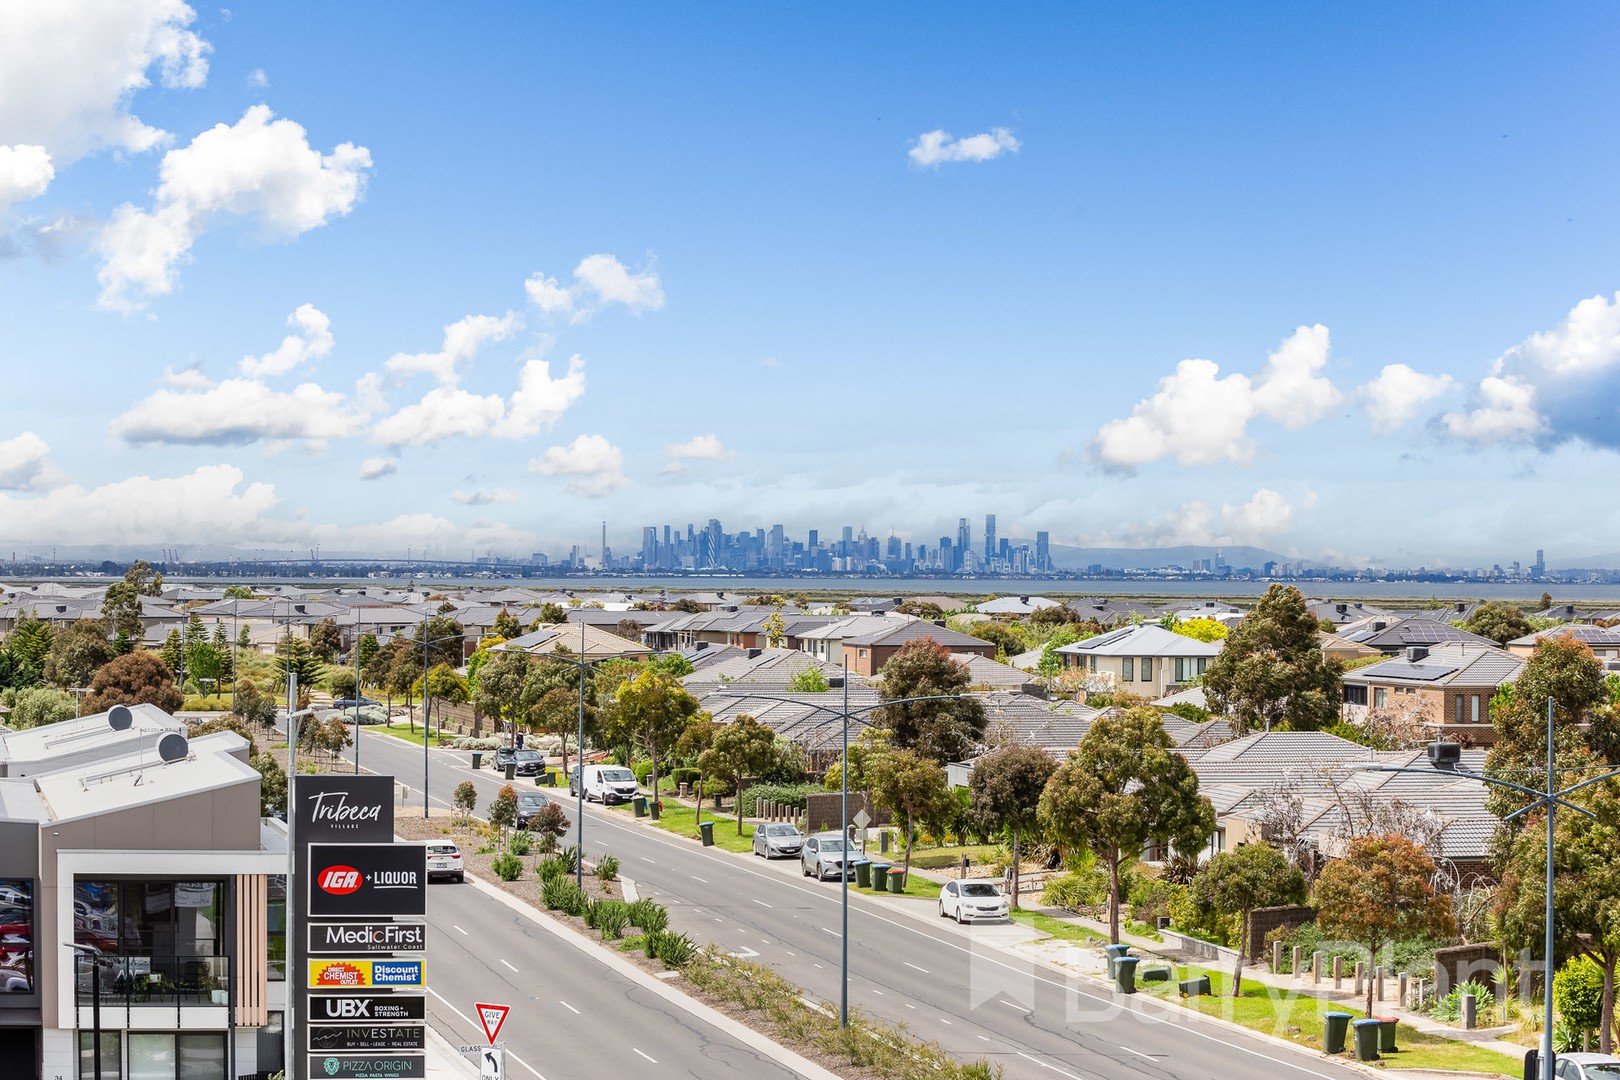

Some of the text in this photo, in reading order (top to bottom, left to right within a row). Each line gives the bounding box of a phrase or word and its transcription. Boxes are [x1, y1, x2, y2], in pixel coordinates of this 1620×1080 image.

[308, 791, 382, 823] Tribeca
[322, 871, 359, 889] IGA
[373, 871, 417, 885] LIQUOR
[325, 925, 423, 944] MedicFirst
[374, 965, 419, 974] Discount
[323, 971, 359, 980] CHEMIST
[374, 973, 417, 981] Chemist
[326, 999, 371, 1017] UBX
[484, 1011, 500, 1019] GIVE
[346, 1028, 420, 1039] INVESTATE
[342, 1060, 412, 1071] PIZZA ORIGIN
